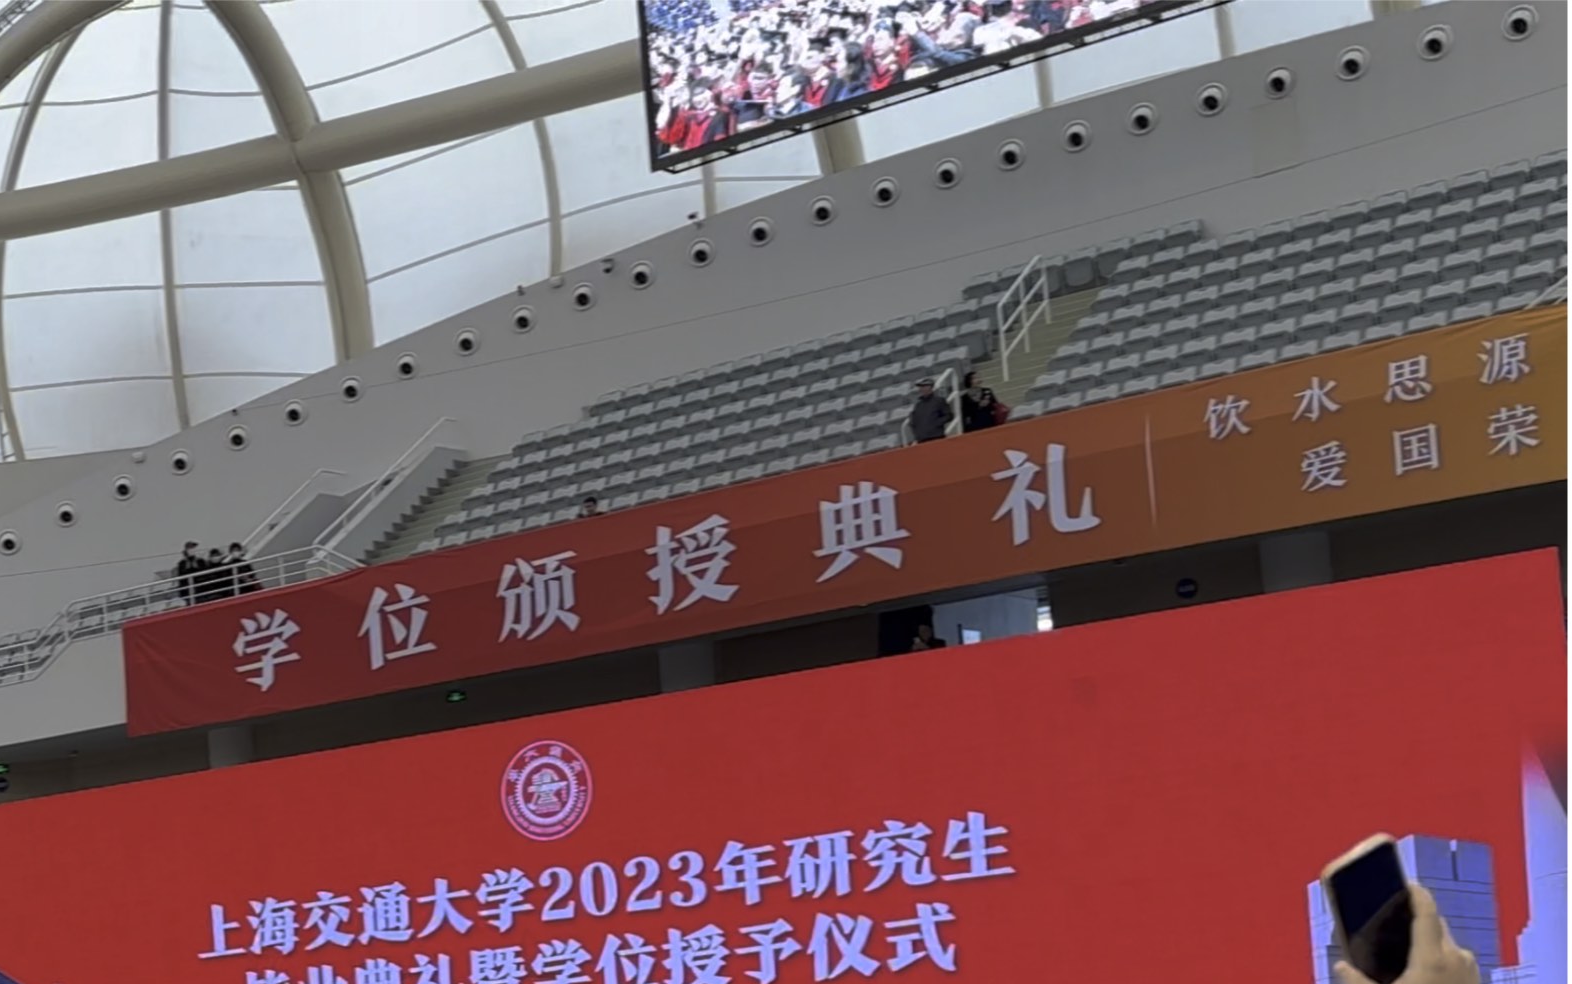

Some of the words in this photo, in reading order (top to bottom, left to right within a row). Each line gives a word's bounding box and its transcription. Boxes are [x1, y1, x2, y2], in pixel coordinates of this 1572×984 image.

[1202, 332, 1532, 440] 饮水思源
[1299, 403, 1541, 492] 爱国荣
[231, 443, 1102, 691] 学位颁授典礼
[197, 811, 1016, 959] 上海交通大学2023年研究生
